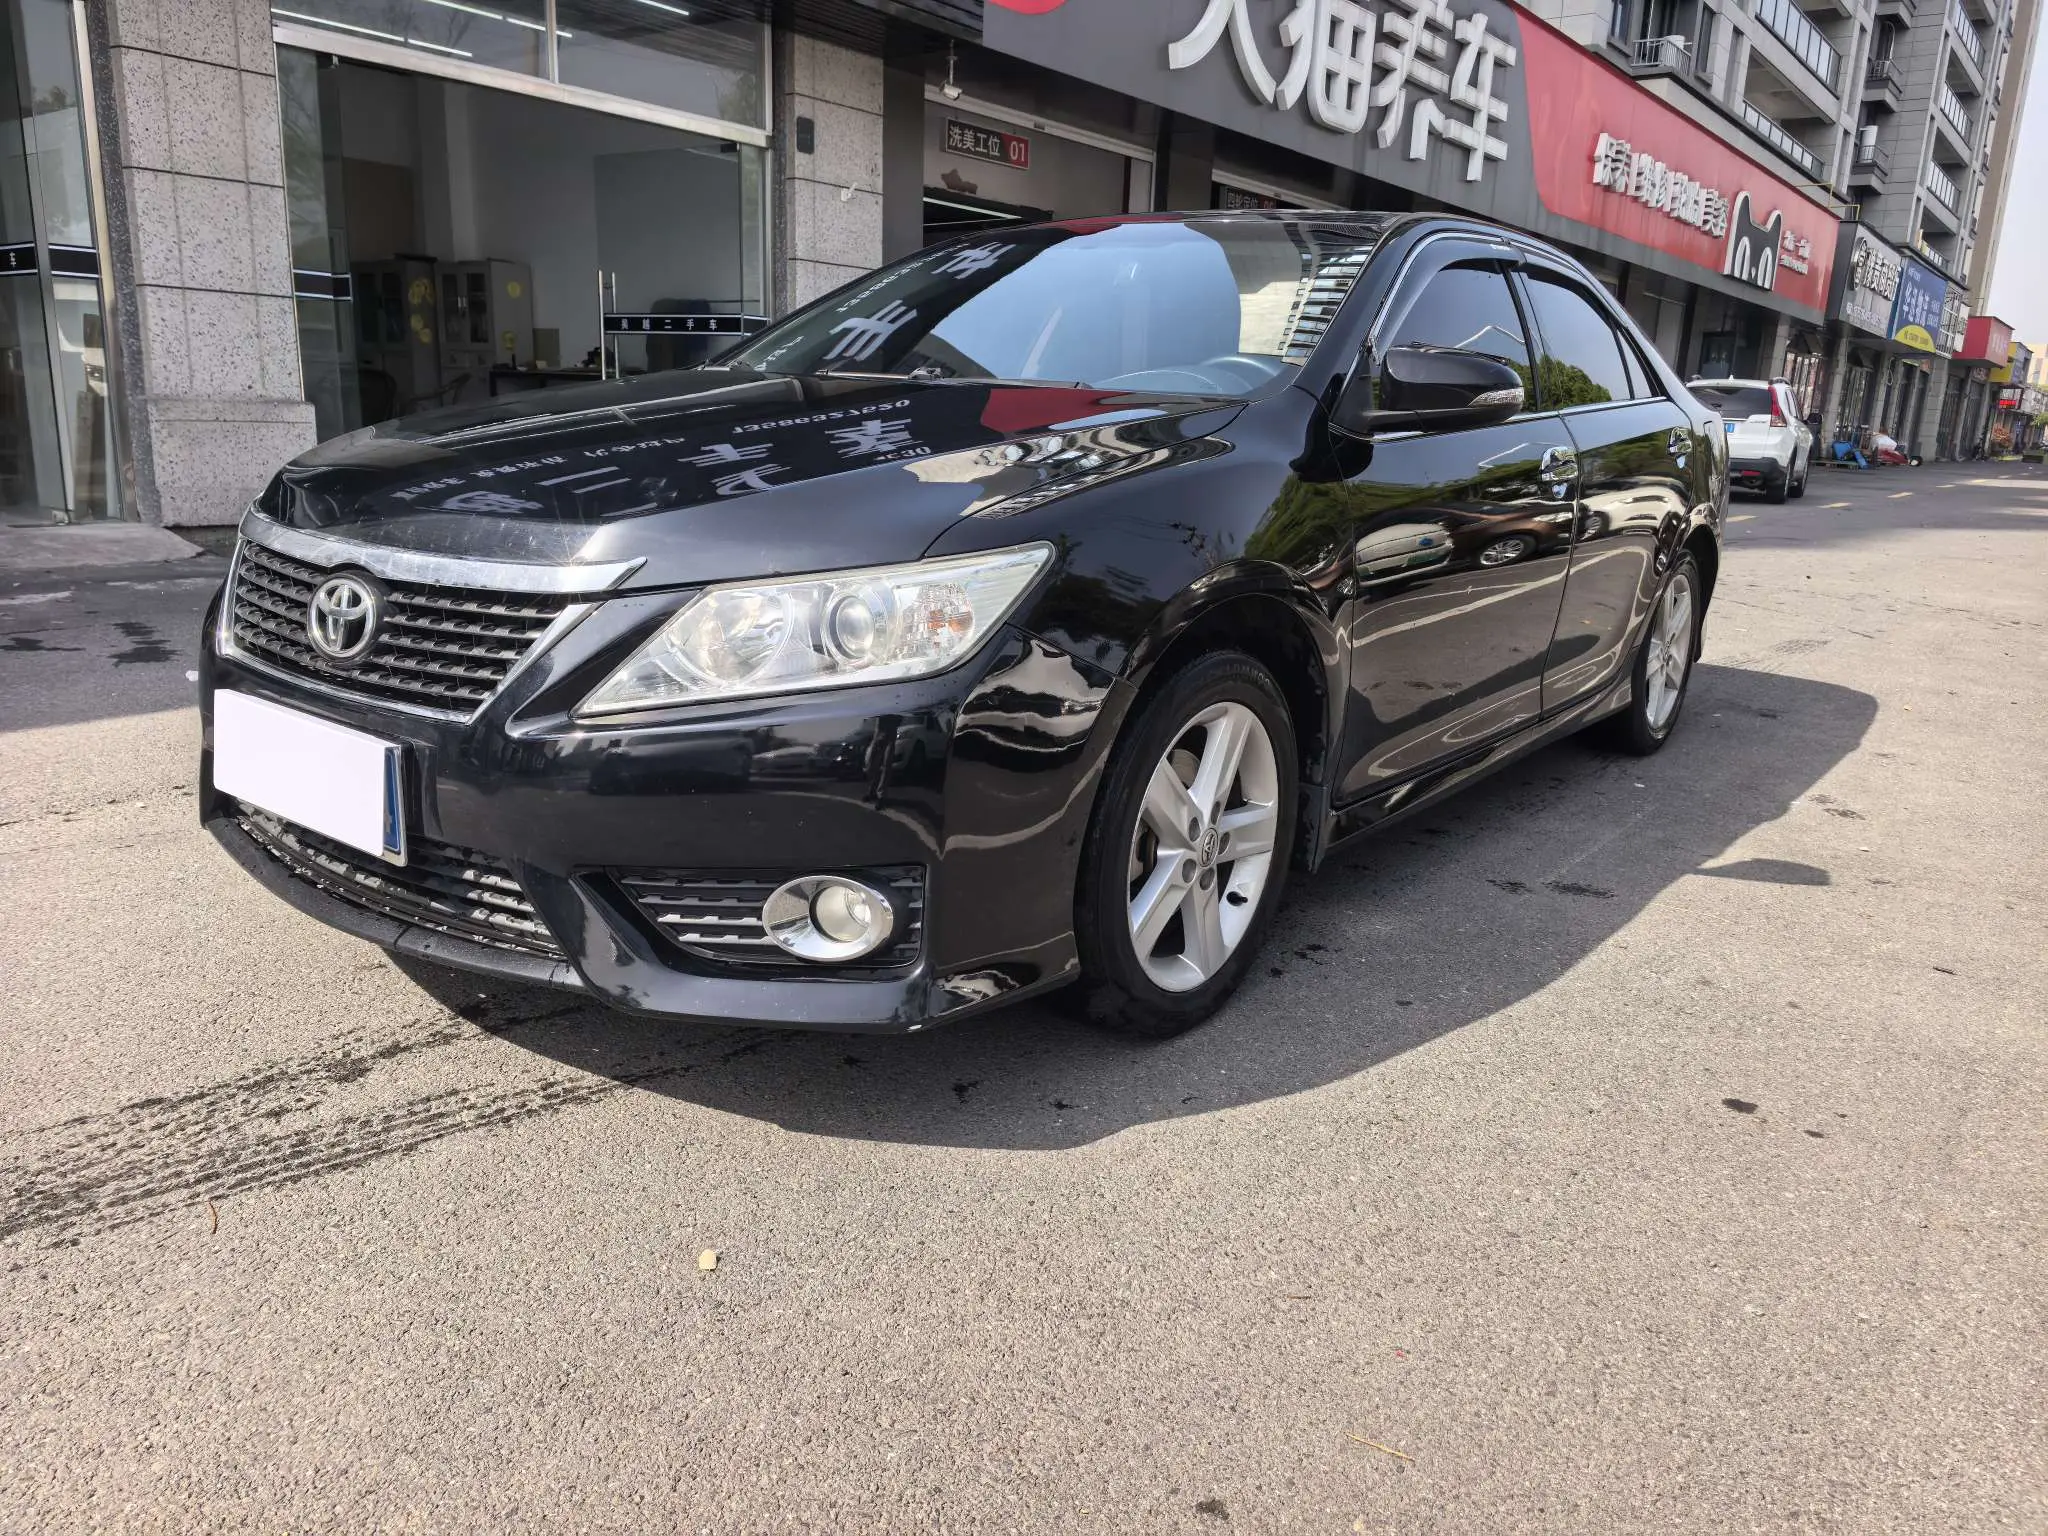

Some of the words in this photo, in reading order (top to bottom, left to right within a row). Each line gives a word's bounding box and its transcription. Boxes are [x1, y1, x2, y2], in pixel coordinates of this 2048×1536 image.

[949, 124, 1000, 157] 洗美工位
[1010, 141, 1025, 162] 01
